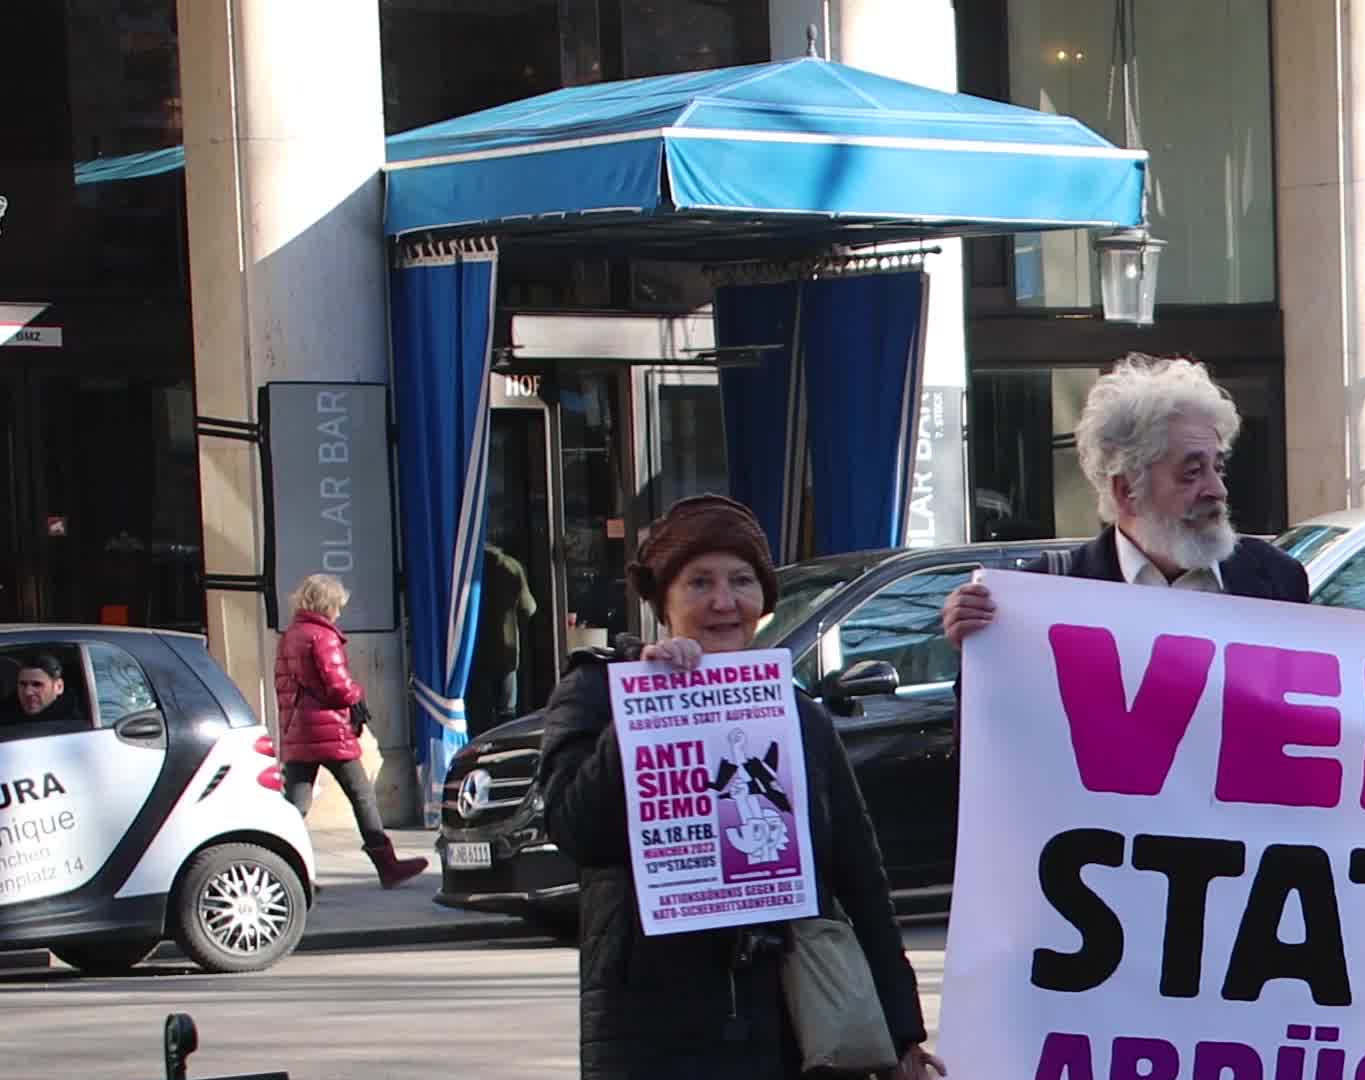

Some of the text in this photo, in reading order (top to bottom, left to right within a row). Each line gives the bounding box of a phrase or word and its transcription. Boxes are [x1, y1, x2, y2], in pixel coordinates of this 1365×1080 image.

[316, 391, 350, 464] BAR
[624, 684, 782, 715] STATT SCHIESSEN!
[629, 706, 785, 731] ABRÜSTEN STATT AUFRÜSTEN
[635, 740, 705, 771] ANTI
[636, 766, 710, 799] SIKO
[639, 795, 713, 822] DEMO
[64, 856, 84, 875] 14
